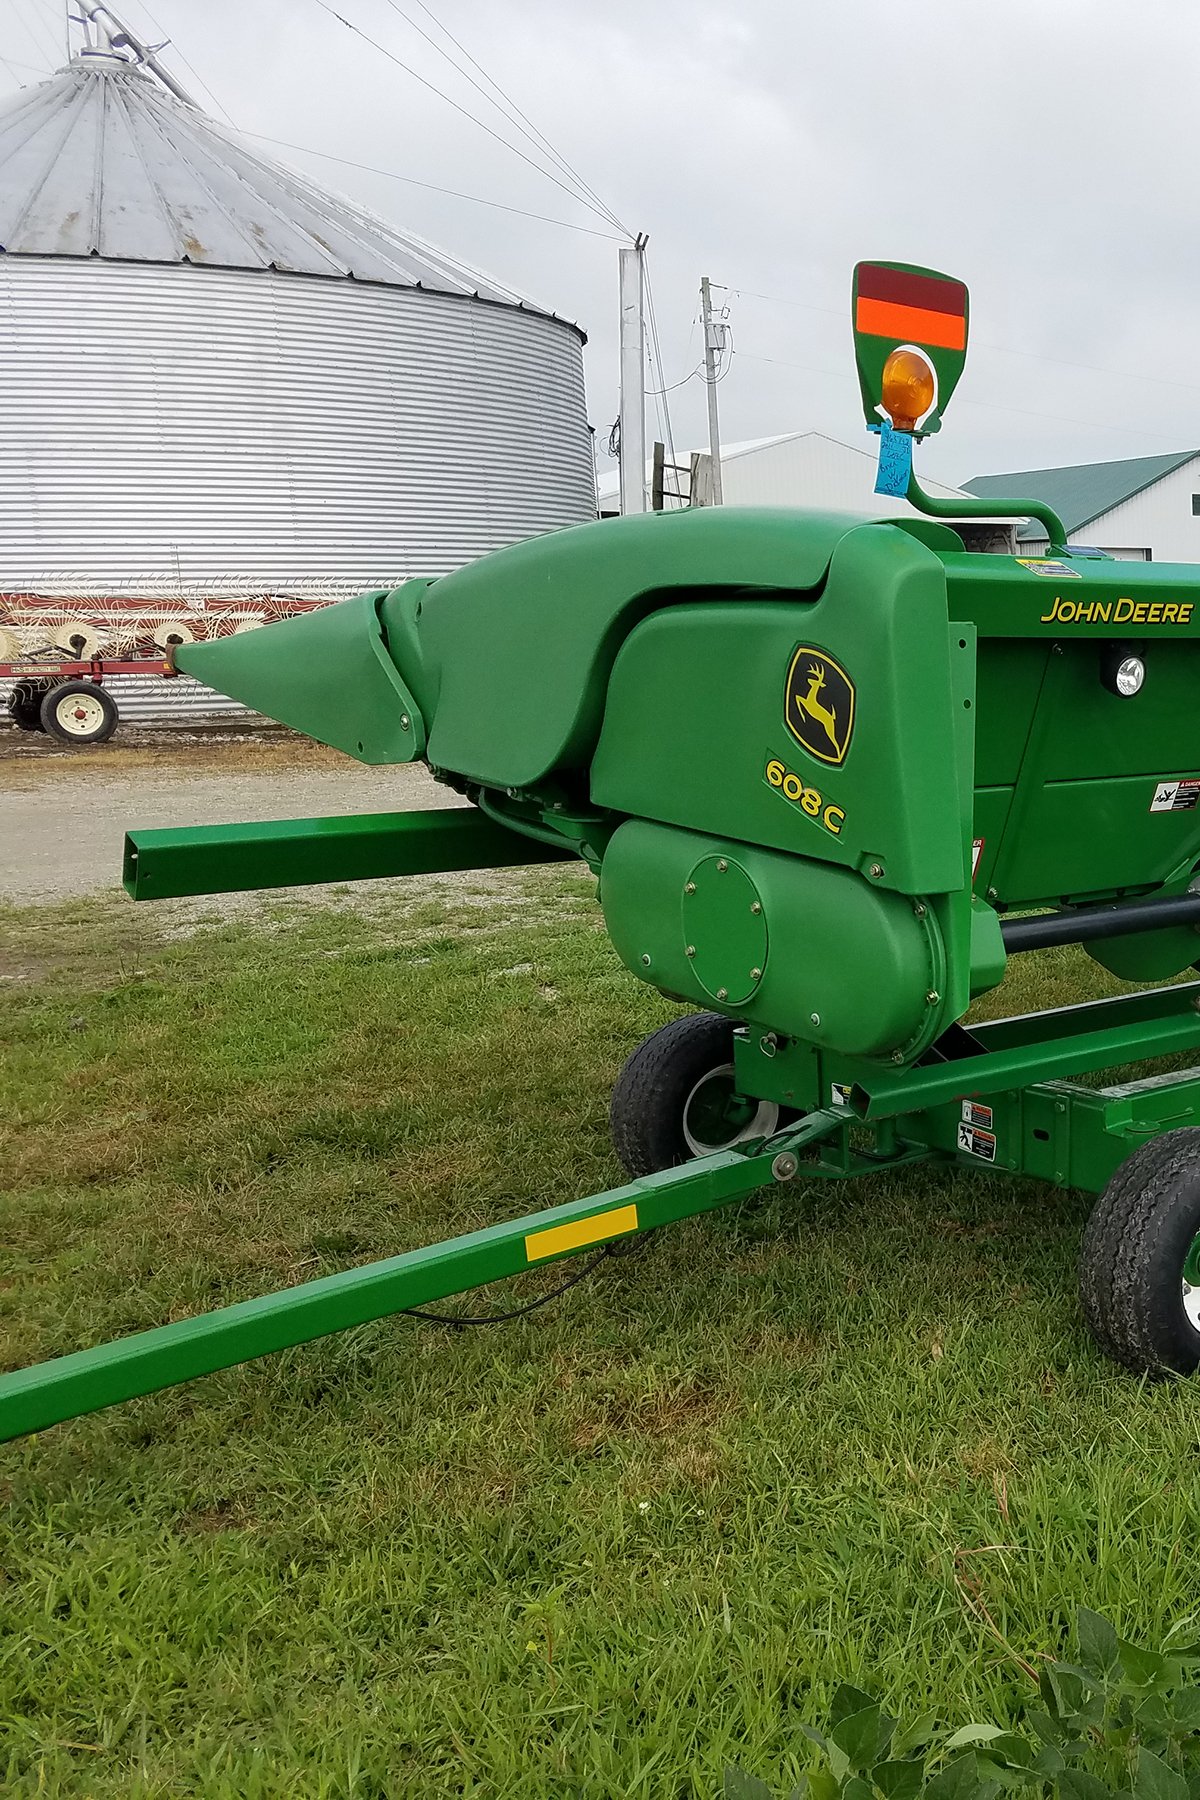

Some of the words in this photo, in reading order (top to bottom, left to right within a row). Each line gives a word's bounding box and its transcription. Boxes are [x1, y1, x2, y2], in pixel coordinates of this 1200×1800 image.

[1041, 596, 1112, 623] JOHN
[1113, 598, 1194, 623] DEERE
[766, 759, 846, 835] 608C
